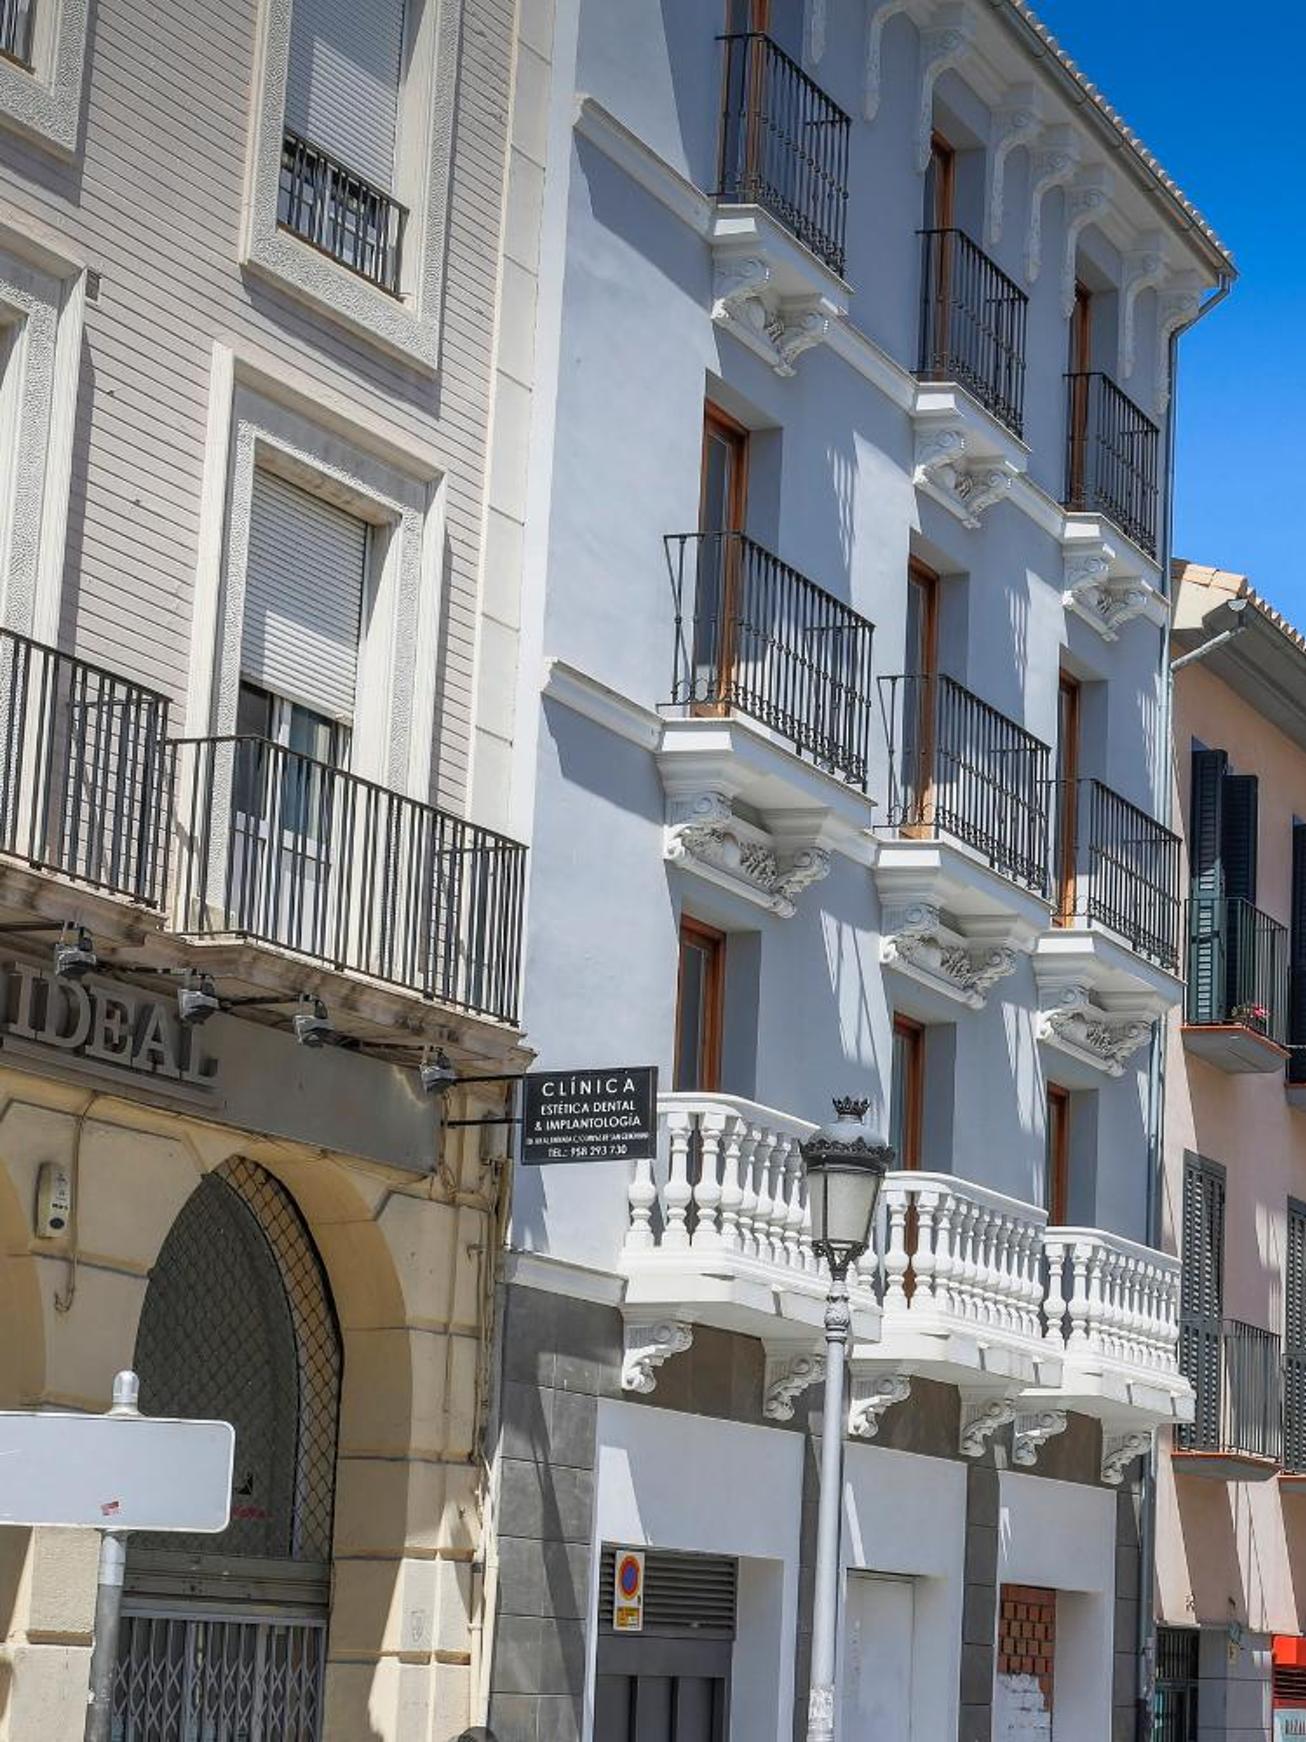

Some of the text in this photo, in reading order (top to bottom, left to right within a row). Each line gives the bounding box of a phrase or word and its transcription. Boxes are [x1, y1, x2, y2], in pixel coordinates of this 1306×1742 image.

[8, 961, 224, 1084] IDEAL
[541, 1076, 636, 1097] CLÍNICA
[540, 1100, 637, 1116] ESTÉTICA DENTAL
[546, 1113, 642, 1131] IMPLANTOLOGÍA
